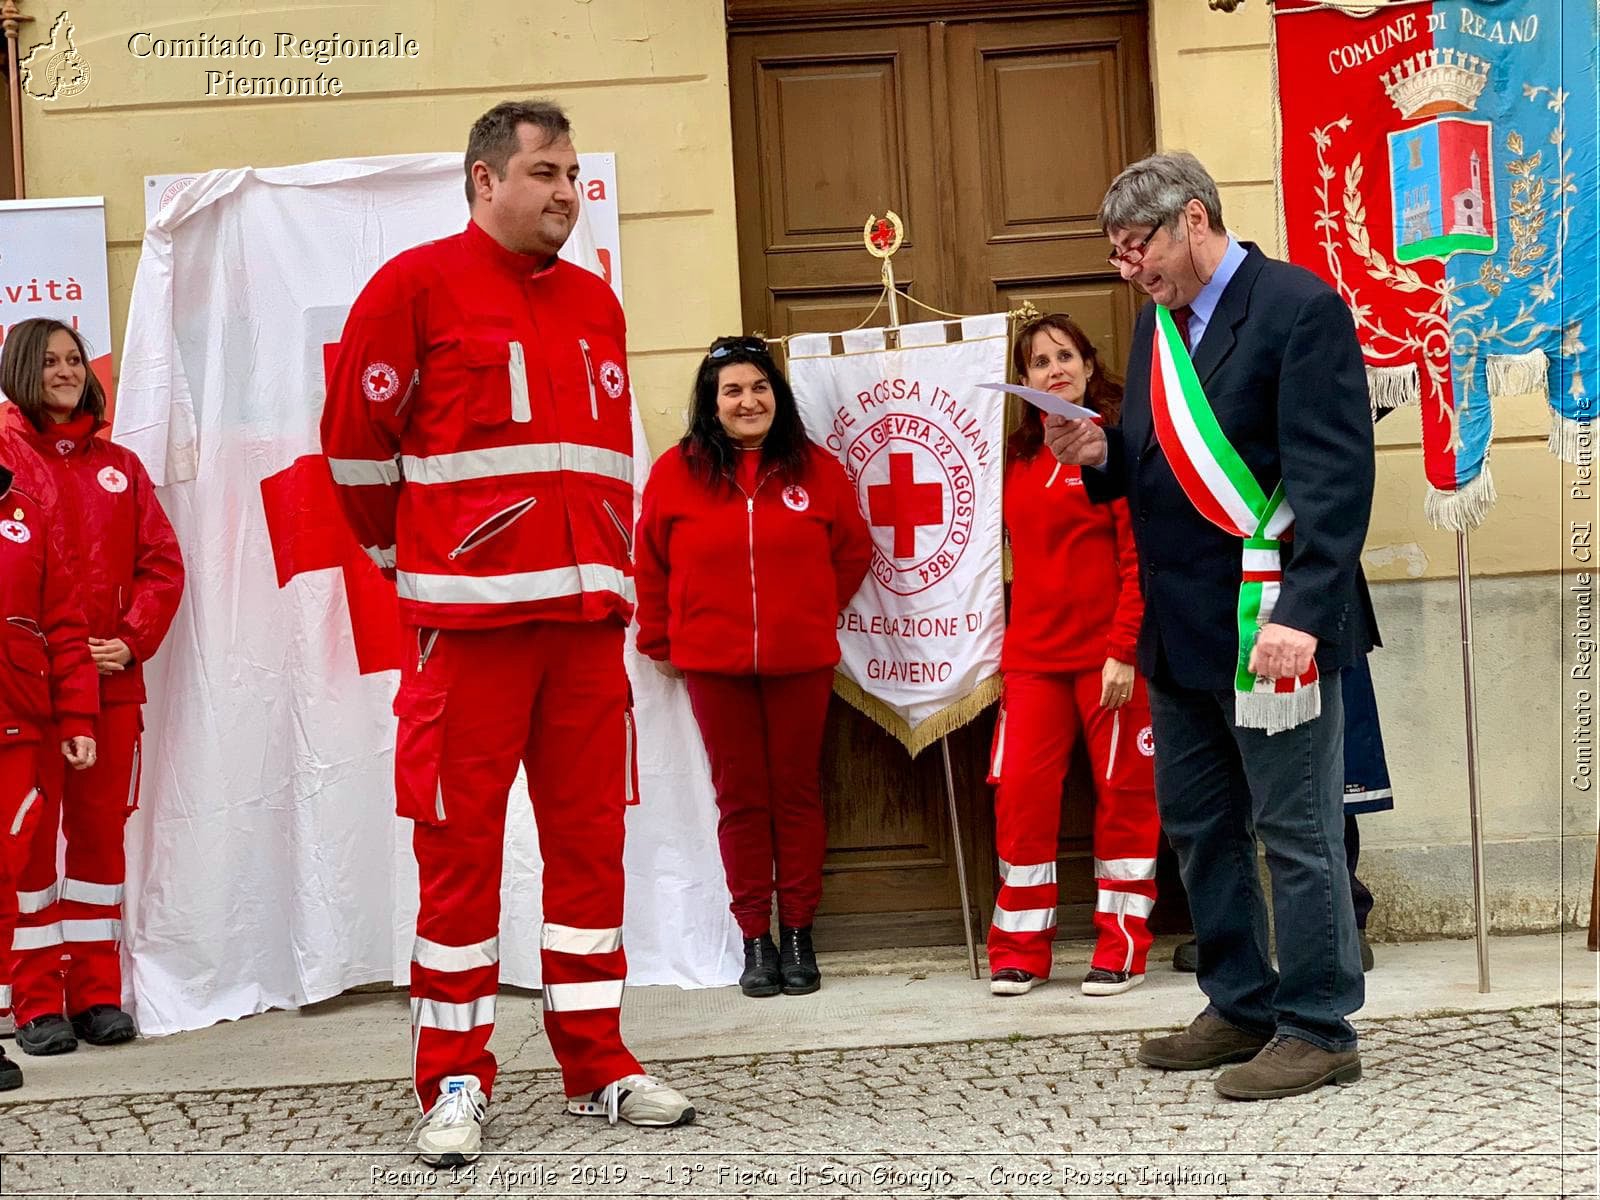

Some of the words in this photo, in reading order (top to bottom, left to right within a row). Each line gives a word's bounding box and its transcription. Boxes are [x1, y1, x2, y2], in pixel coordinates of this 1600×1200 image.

[1328, 12, 1418, 75] COMUNE
[1426, 12, 1447, 33] DI
[1459, 8, 1538, 45] REANO
[0, 276, 82, 303] vità
[826, 406, 856, 451] OCE
[857, 378, 921, 413] ROSSA
[851, 440, 871, 462] DI
[934, 436, 952, 460] 22
[948, 464, 973, 546] AGOSTO
[919, 550, 954, 584] 1864
[836, 613, 958, 638] DELEGAZIONE
[965, 611, 983, 633] DI
[867, 658, 952, 683] GIAVENO
